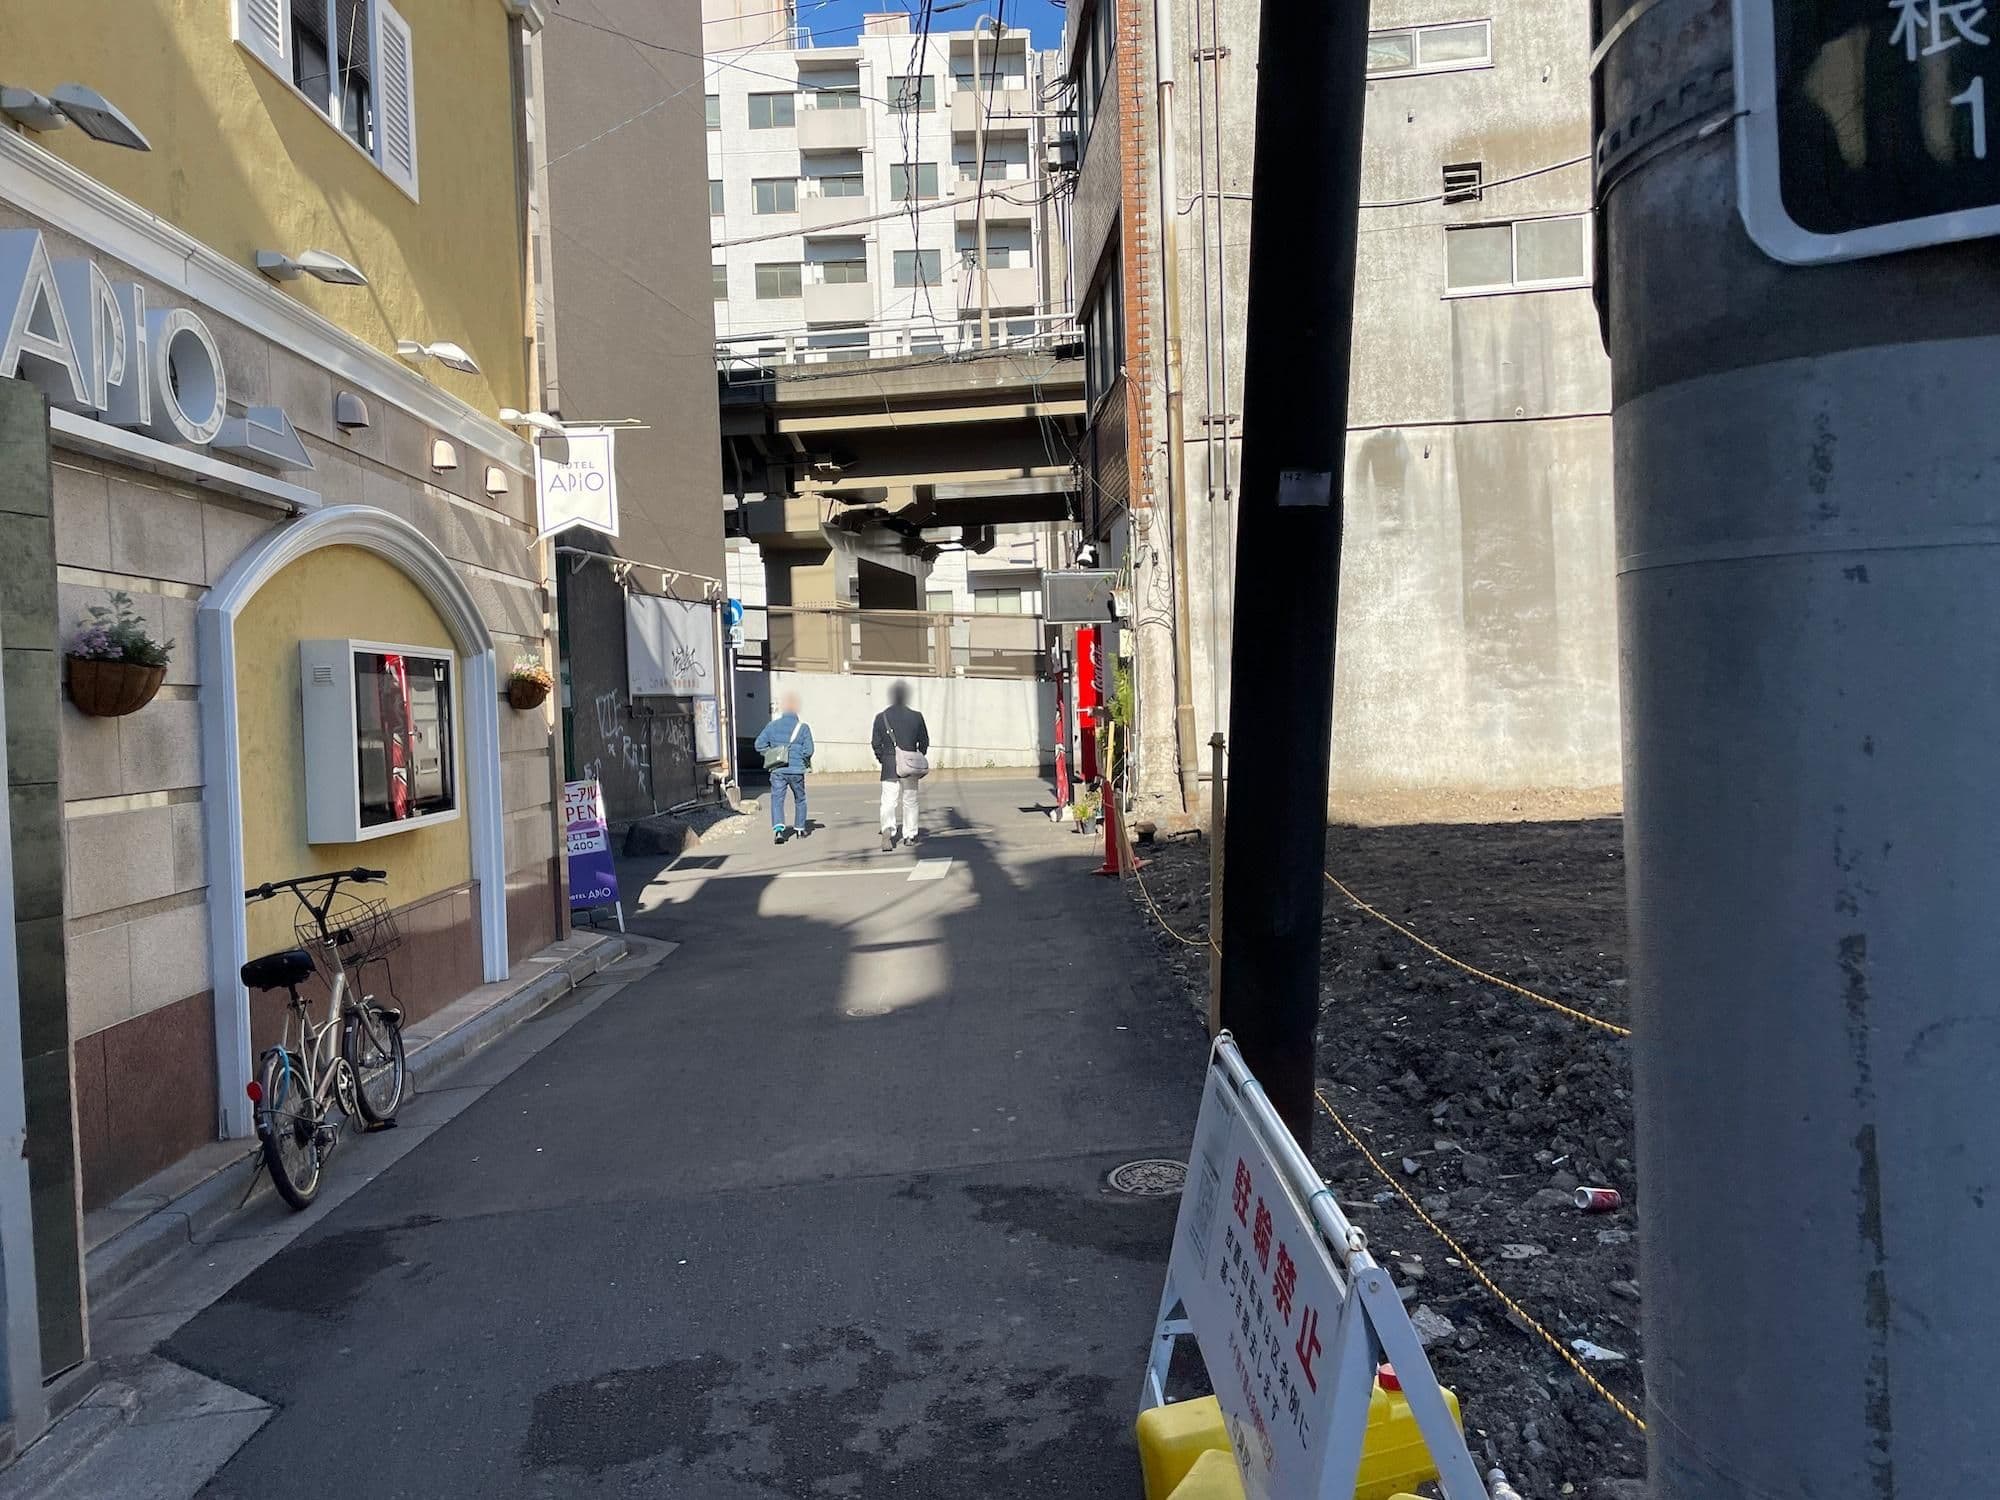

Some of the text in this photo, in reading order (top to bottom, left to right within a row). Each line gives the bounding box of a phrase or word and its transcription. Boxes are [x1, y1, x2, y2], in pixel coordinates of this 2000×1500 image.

[1949, 75, 1988, 160] 1
[557, 461, 595, 470] HOTEL
[564, 785, 597, 803] ューアル
[565, 804, 598, 822] PEN
[1232, 1156, 1322, 1395] 駐輪禁止
